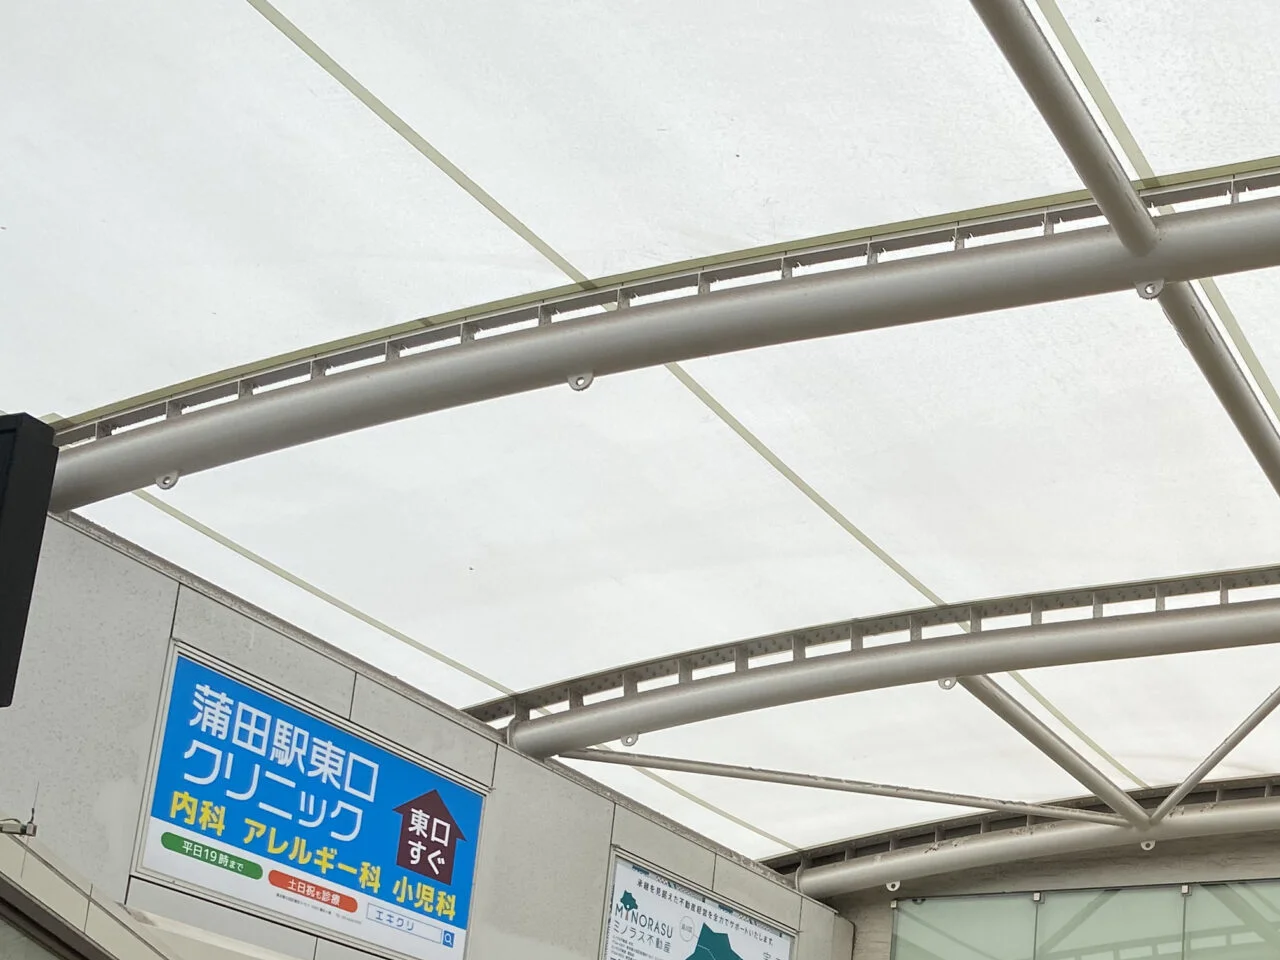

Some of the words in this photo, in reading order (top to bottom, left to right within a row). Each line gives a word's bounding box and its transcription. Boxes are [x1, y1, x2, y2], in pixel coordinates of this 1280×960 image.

[189, 684, 379, 802] 蒲田駅東口
[184, 739, 363, 841] クリニック
[408, 808, 451, 847] 東口
[170, 791, 226, 835] 内科
[244, 818, 381, 893] アレルギー科
[392, 877, 456, 920] 小児科
[182, 840, 244, 871] 平日19時まで
[408, 841, 446, 875] すぐ
[288, 879, 341, 907] 土日祝も診療
[375, 910, 415, 931] エキクリ
[613, 920, 671, 954] ミノラス不動産
[615, 904, 673, 939] MINORASU
